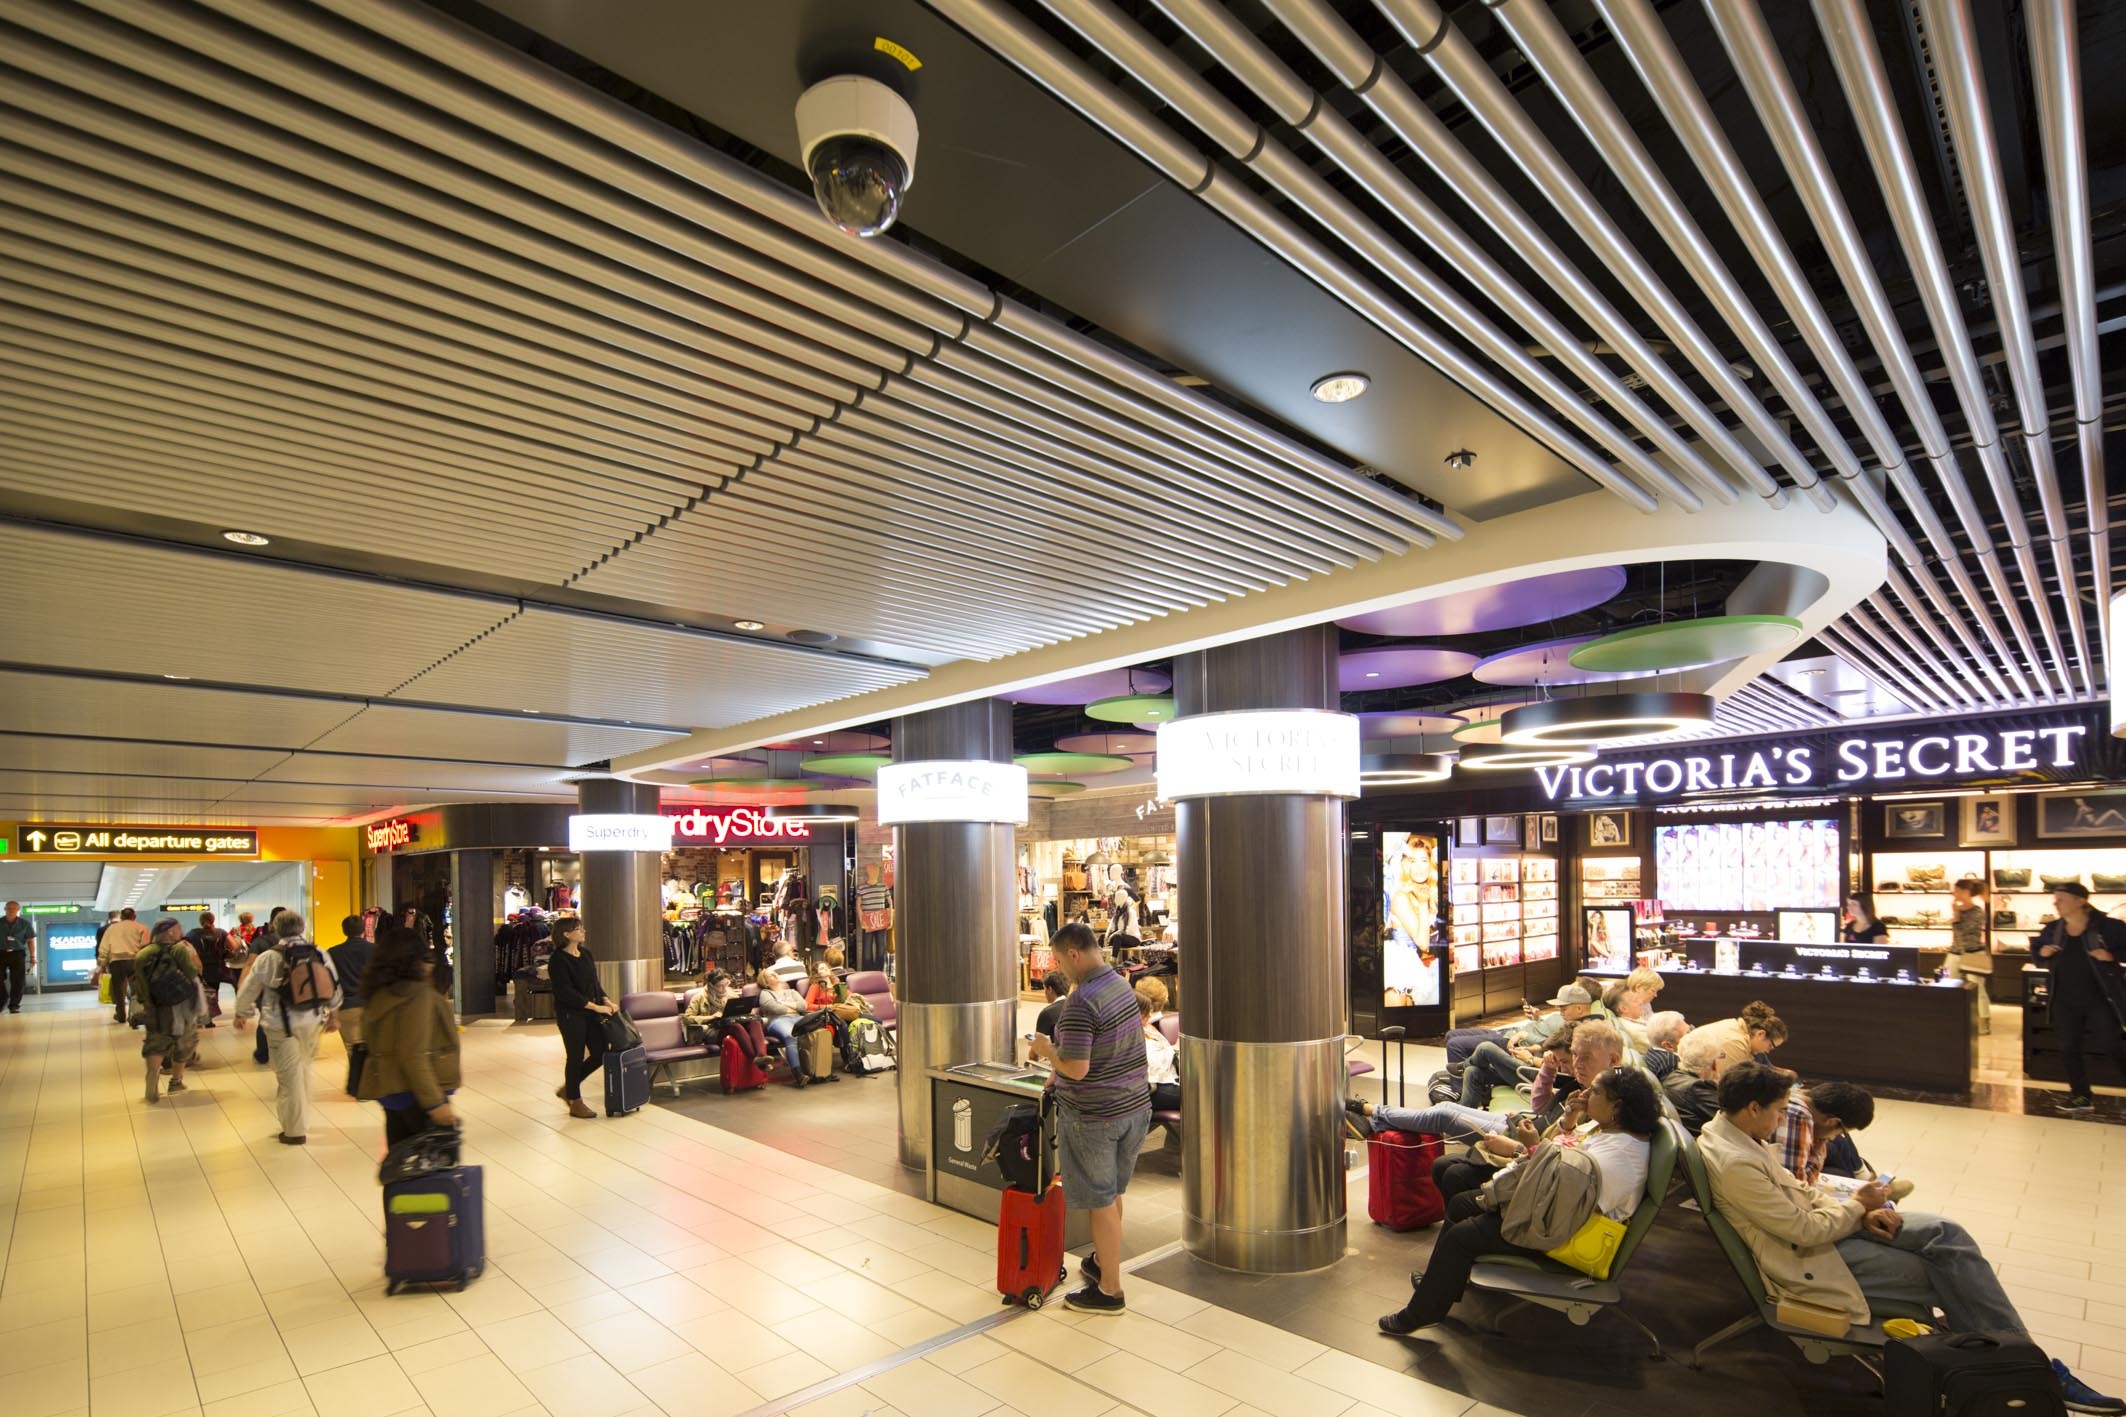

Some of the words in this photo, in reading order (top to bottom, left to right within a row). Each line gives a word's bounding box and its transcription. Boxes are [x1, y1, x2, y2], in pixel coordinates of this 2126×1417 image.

[1534, 747, 1812, 800] VICTORIA'S
[1837, 726, 2086, 782] SECRET
[898, 771, 993, 798] FATFACE
[85, 832, 109, 848] All
[113, 833, 201, 851] departure
[204, 836, 250, 852] gates
[586, 824, 648, 841] Superdry
